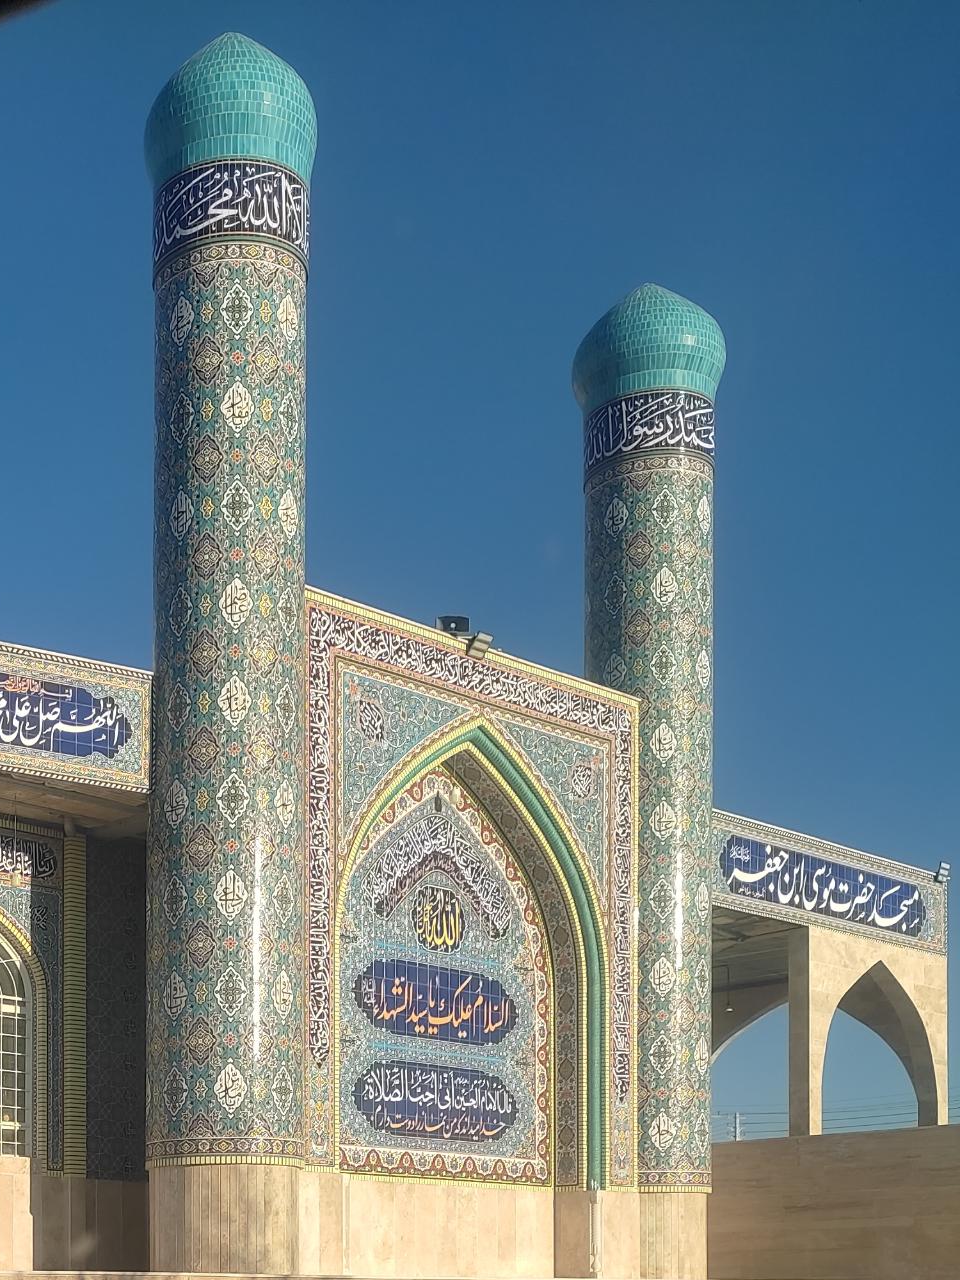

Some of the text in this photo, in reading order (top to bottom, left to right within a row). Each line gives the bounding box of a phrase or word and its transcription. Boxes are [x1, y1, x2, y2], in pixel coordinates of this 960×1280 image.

[0, 697, 33, 743] علی
[18, 699, 61, 747] صل
[50, 700, 123, 752] اللهم
[726, 846, 920, 933] مسجد حضرت موسی ابن جعفر
[372, 977, 413, 1023] الشهداء
[429, 976, 474, 1038] علیک
[472, 996, 510, 1038] السلام
[454, 1087, 481, 1112] الحسین
[497, 1087, 513, 1114] قال
[480, 1115, 506, 1137] خدا
